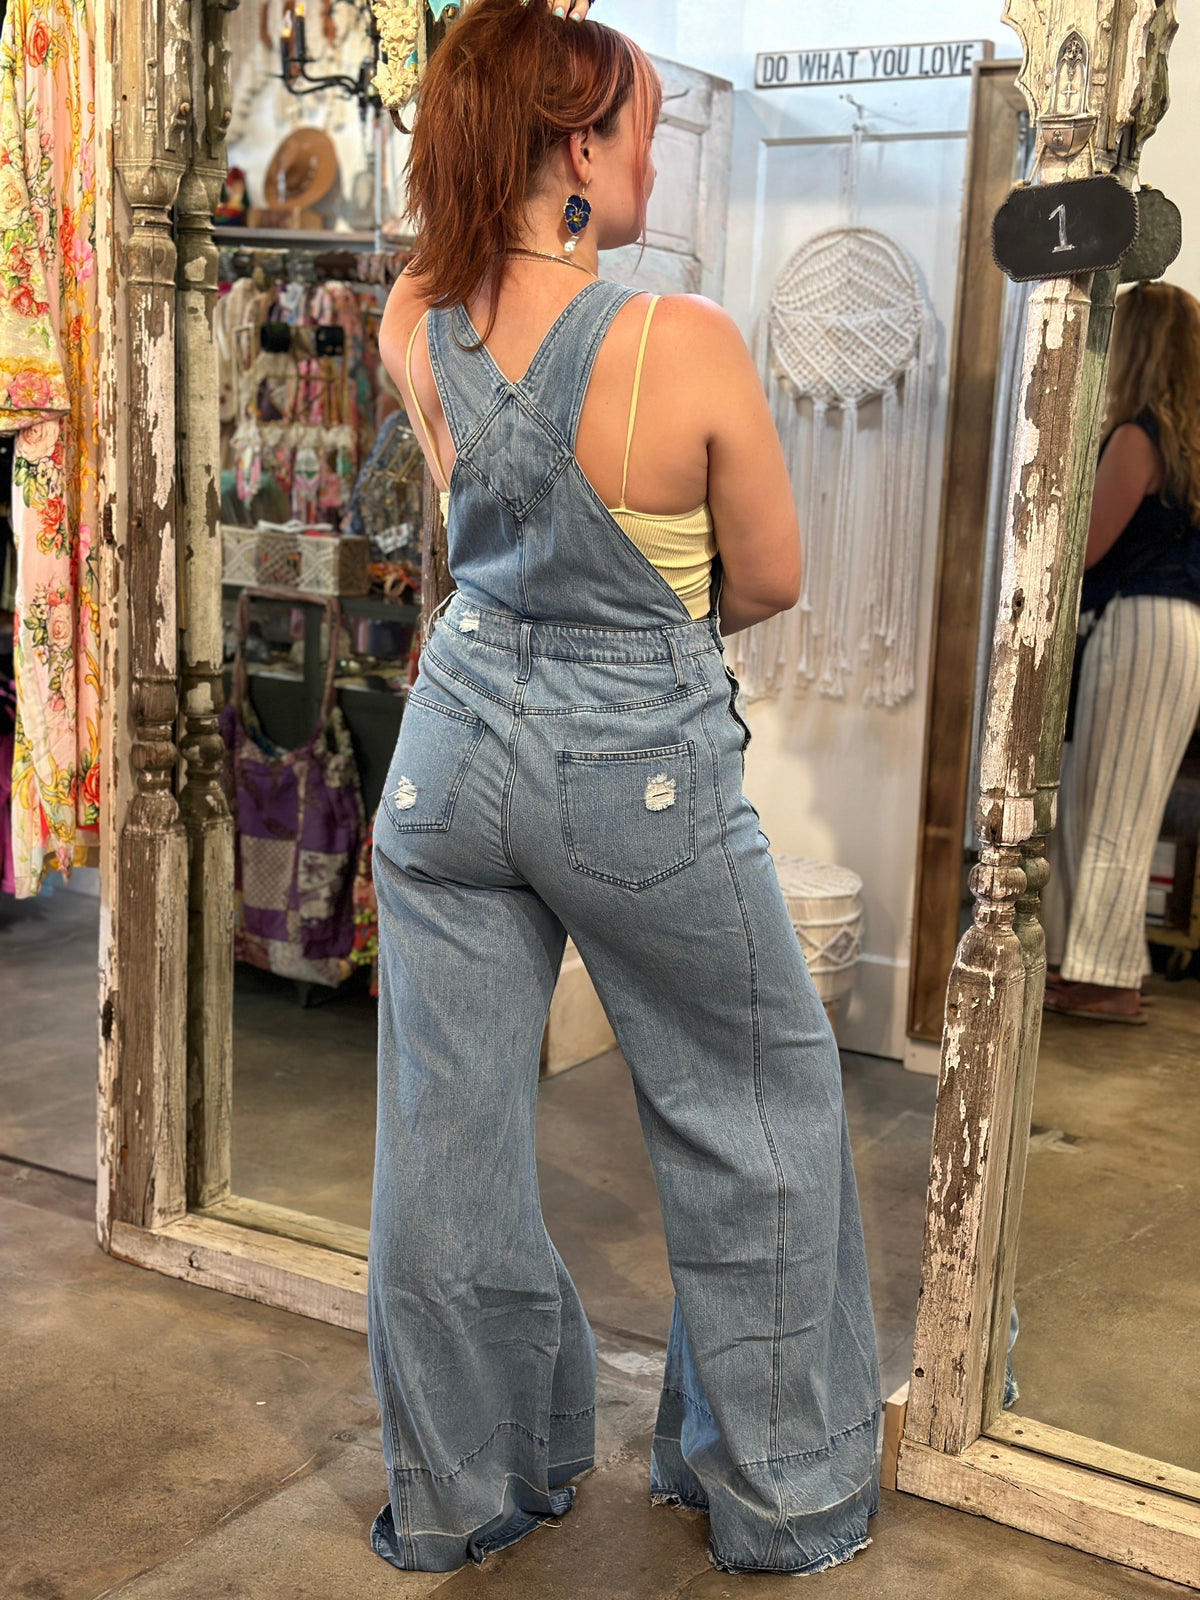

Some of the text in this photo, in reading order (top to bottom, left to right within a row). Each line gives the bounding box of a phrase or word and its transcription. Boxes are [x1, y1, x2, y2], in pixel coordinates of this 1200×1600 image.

[763, 44, 974, 83] DO WHAT YOU LOVE
[1048, 203, 1076, 254] 1
